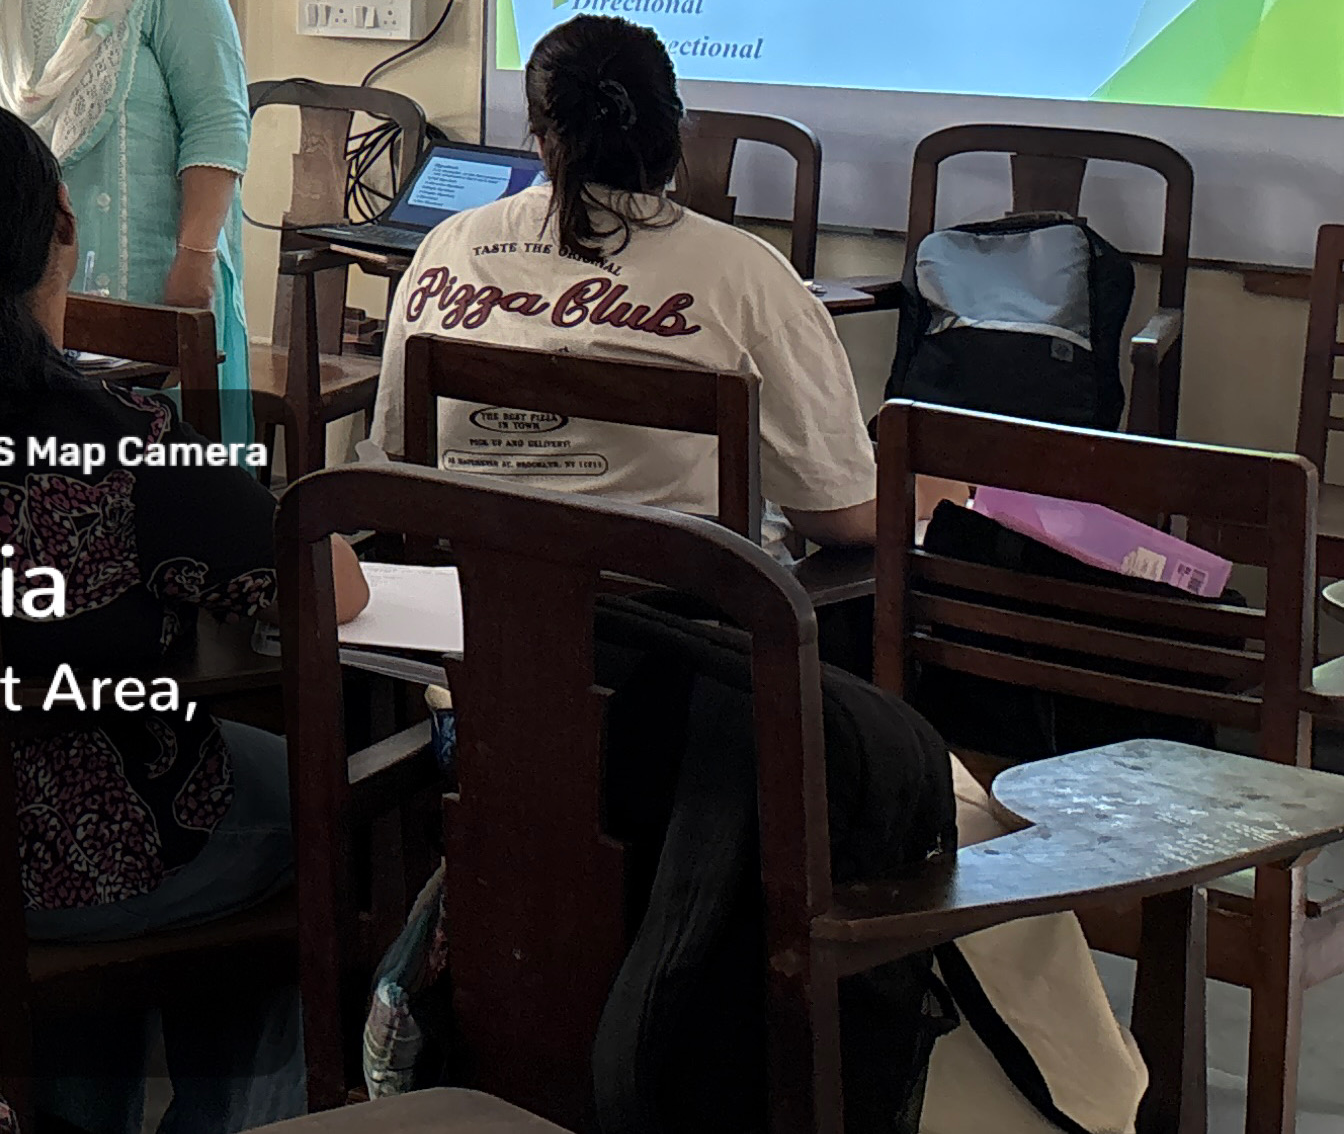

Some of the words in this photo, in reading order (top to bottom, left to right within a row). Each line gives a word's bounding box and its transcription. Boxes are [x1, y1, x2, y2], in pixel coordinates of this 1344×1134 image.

[667, 35, 764, 60] ectional
[473, 242, 517, 256] TASTE
[524, 242, 554, 255] THE
[406, 266, 549, 330] Pizza
[550, 277, 702, 337] Club
